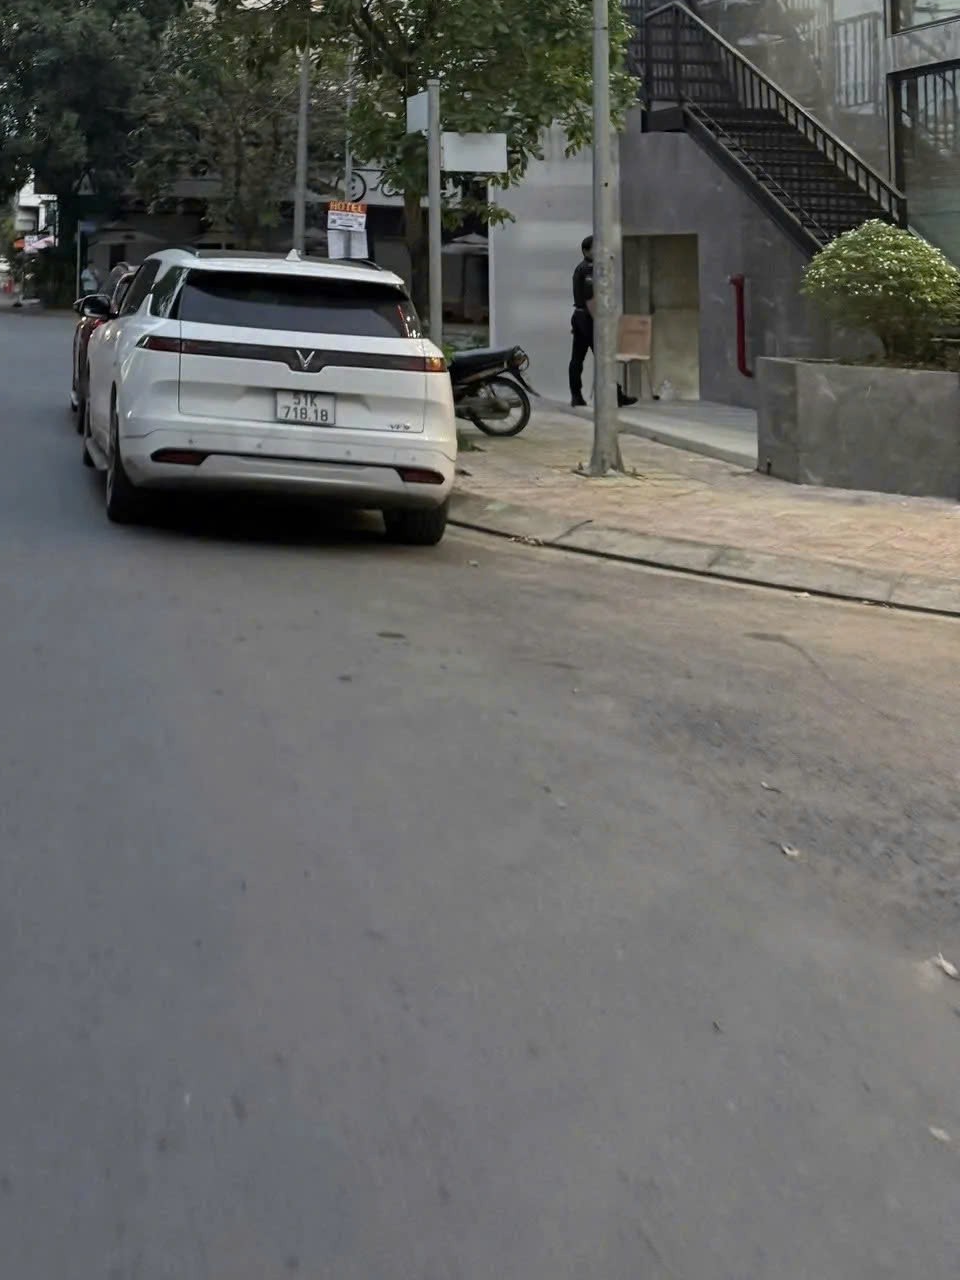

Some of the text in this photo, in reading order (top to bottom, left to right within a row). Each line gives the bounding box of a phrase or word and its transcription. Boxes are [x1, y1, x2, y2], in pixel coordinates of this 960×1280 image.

[329, 201, 363, 213] HOTEL
[292, 392, 318, 407] 51K
[282, 406, 329, 422] 718.18
